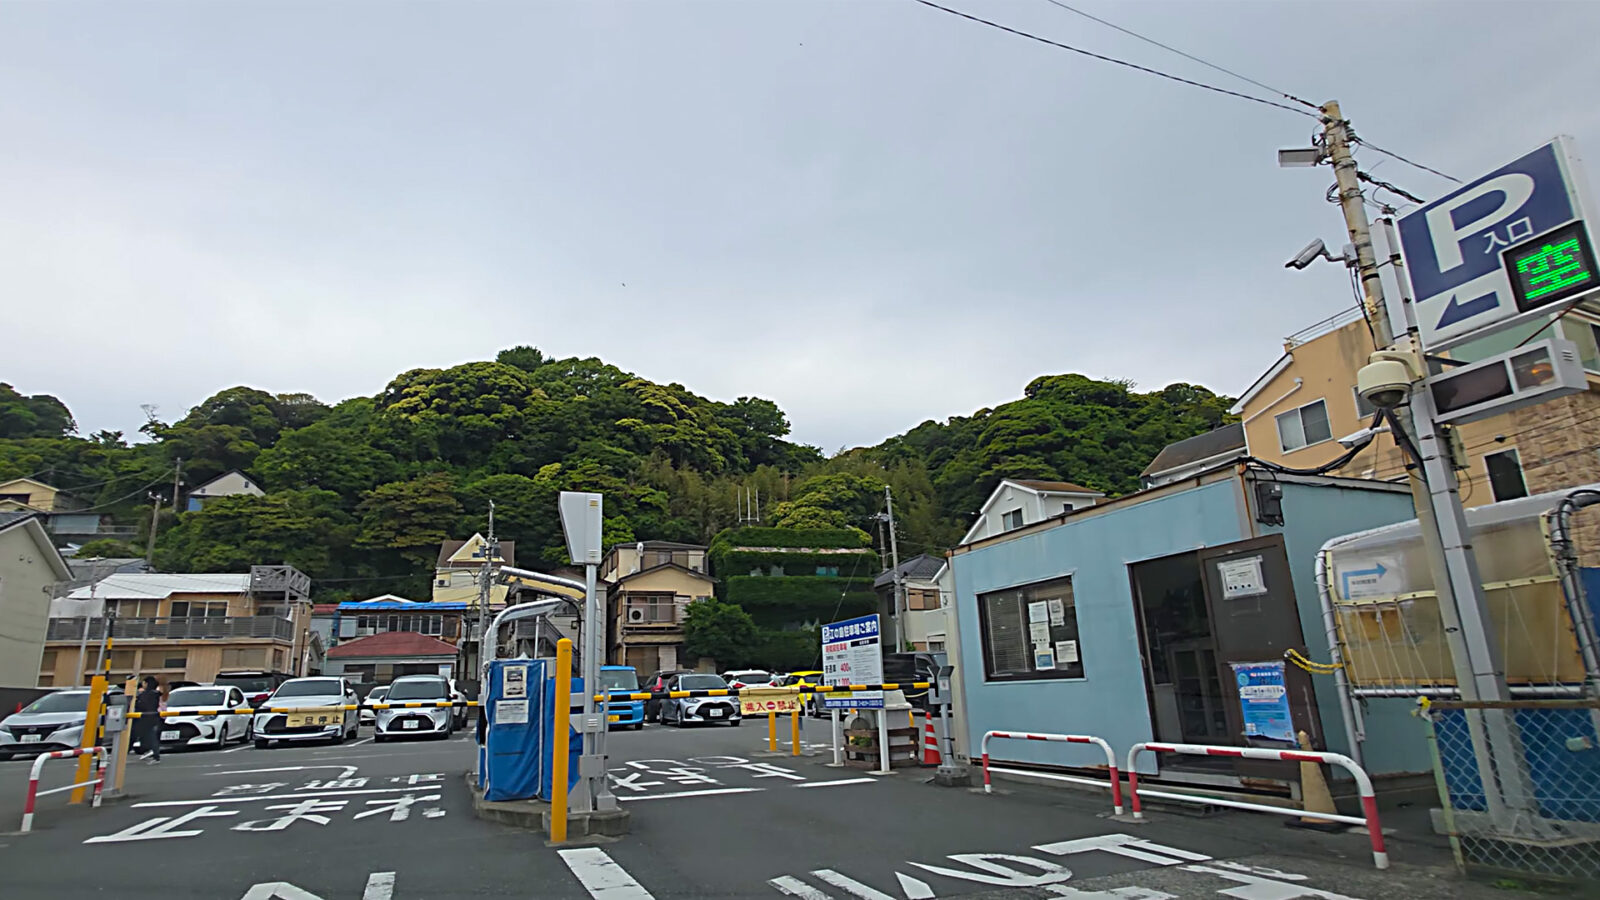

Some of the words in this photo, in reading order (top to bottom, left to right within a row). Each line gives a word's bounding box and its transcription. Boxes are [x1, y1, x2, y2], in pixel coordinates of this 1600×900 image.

[1425, 173, 1536, 275] P
[1484, 216, 1534, 255] 入口
[1516, 238, 1591, 301] 空
[290, 714, 340, 725] 一旦停止
